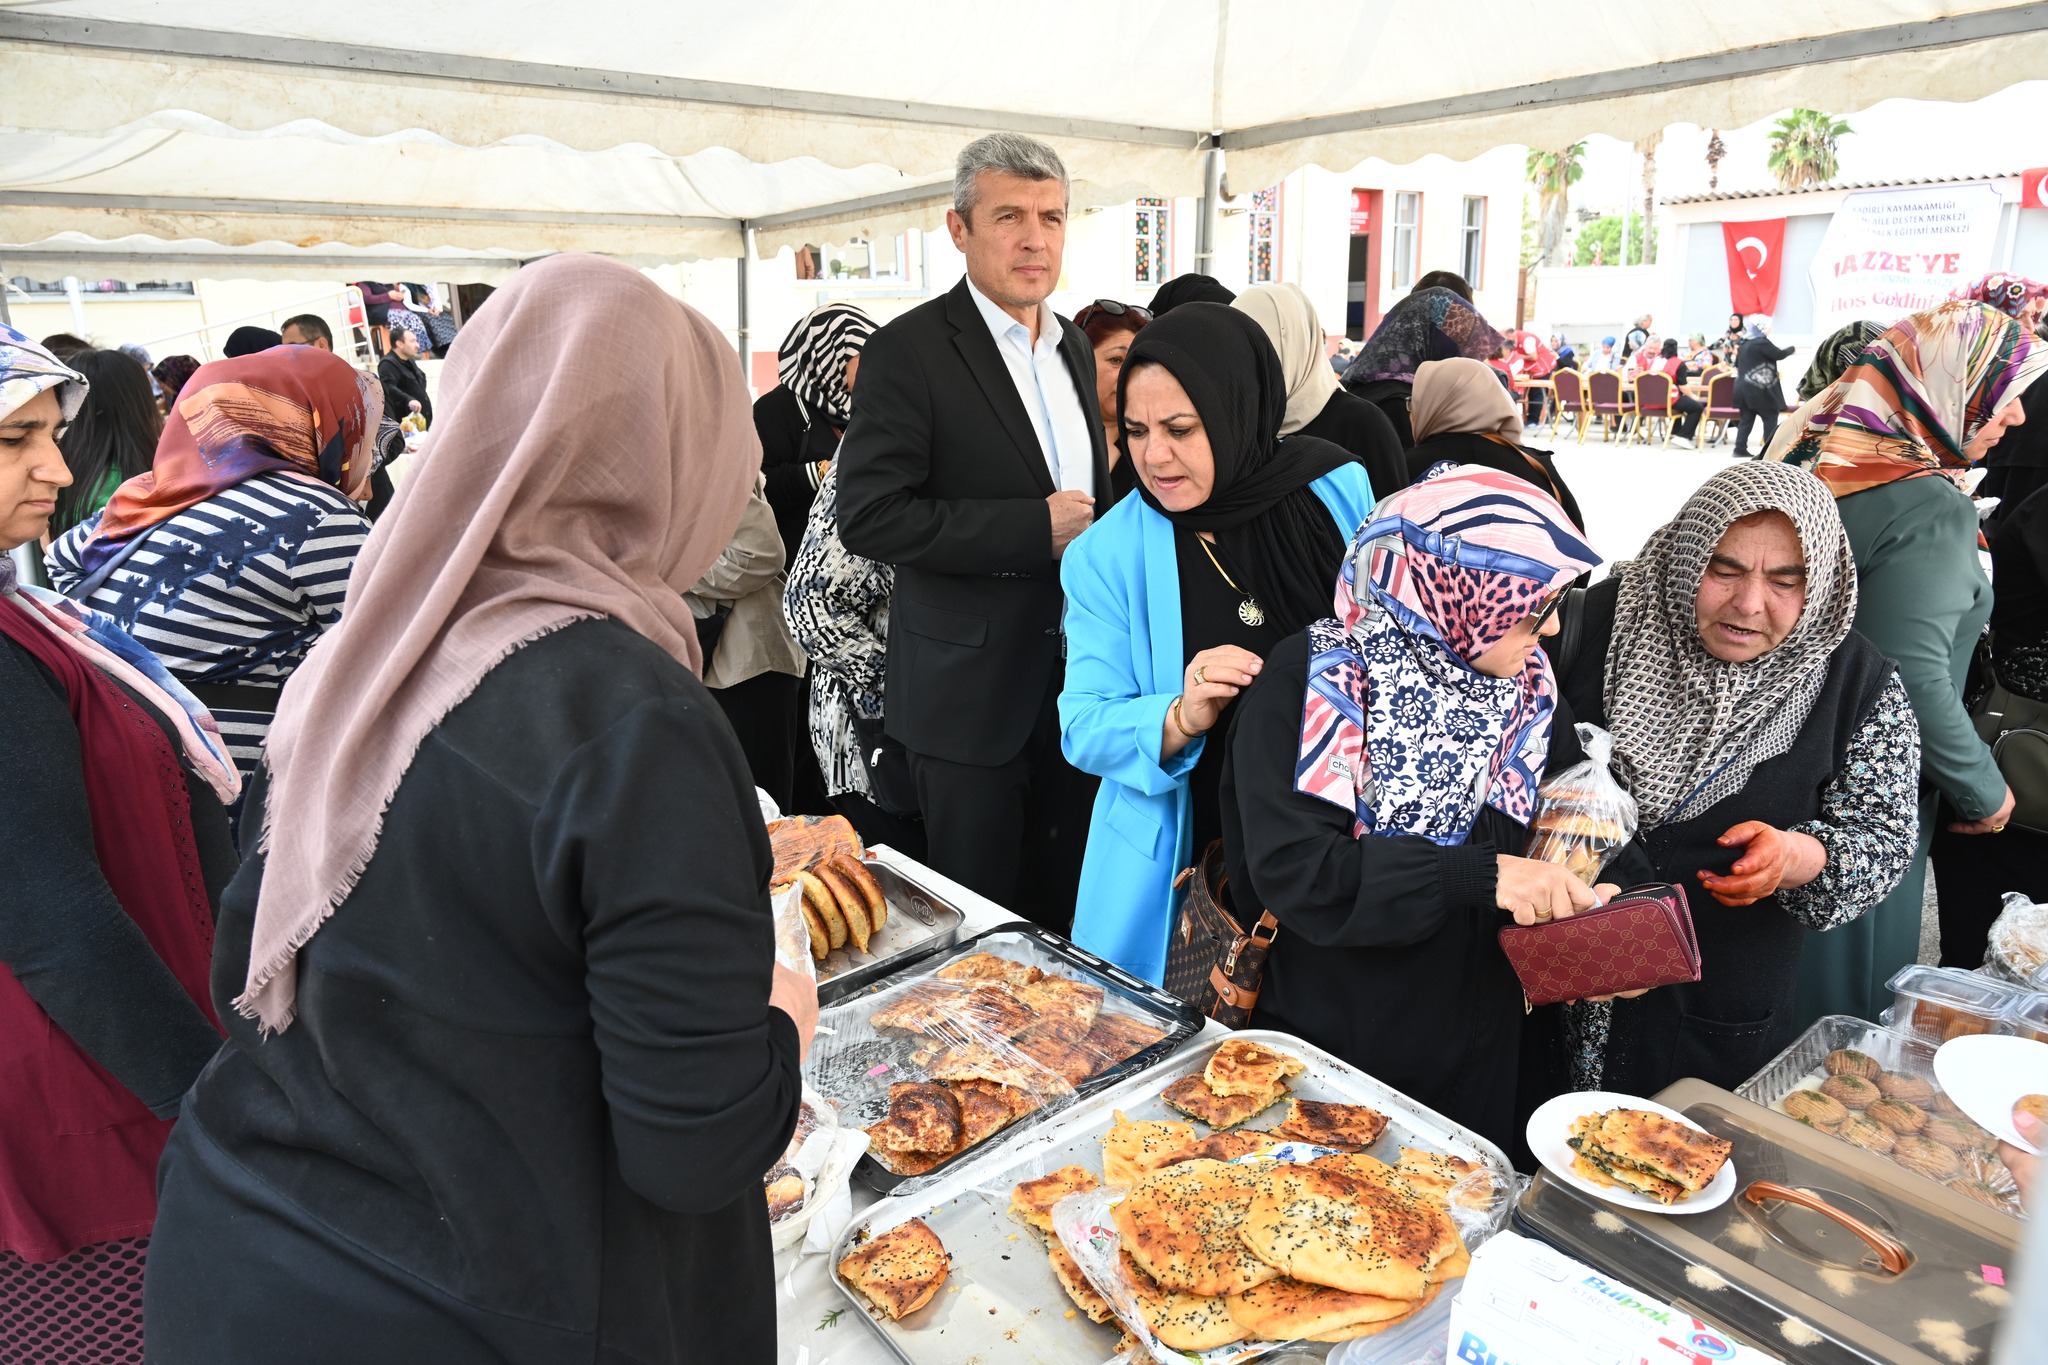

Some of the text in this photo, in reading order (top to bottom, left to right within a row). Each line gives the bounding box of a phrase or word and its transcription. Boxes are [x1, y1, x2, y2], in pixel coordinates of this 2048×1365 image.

[1886, 200, 1956, 213] KAYMAKAMLIĞI
[1892, 214, 1924, 226] DESTEK
[1926, 208, 1967, 223] MERKEZİ
[1894, 225, 1929, 237] EĞİTİMİ
[1930, 220, 1970, 234] MERKEZİ
[1834, 251, 1961, 278] AZZE'YE
[1675, 1345, 1697, 1360] PVC
